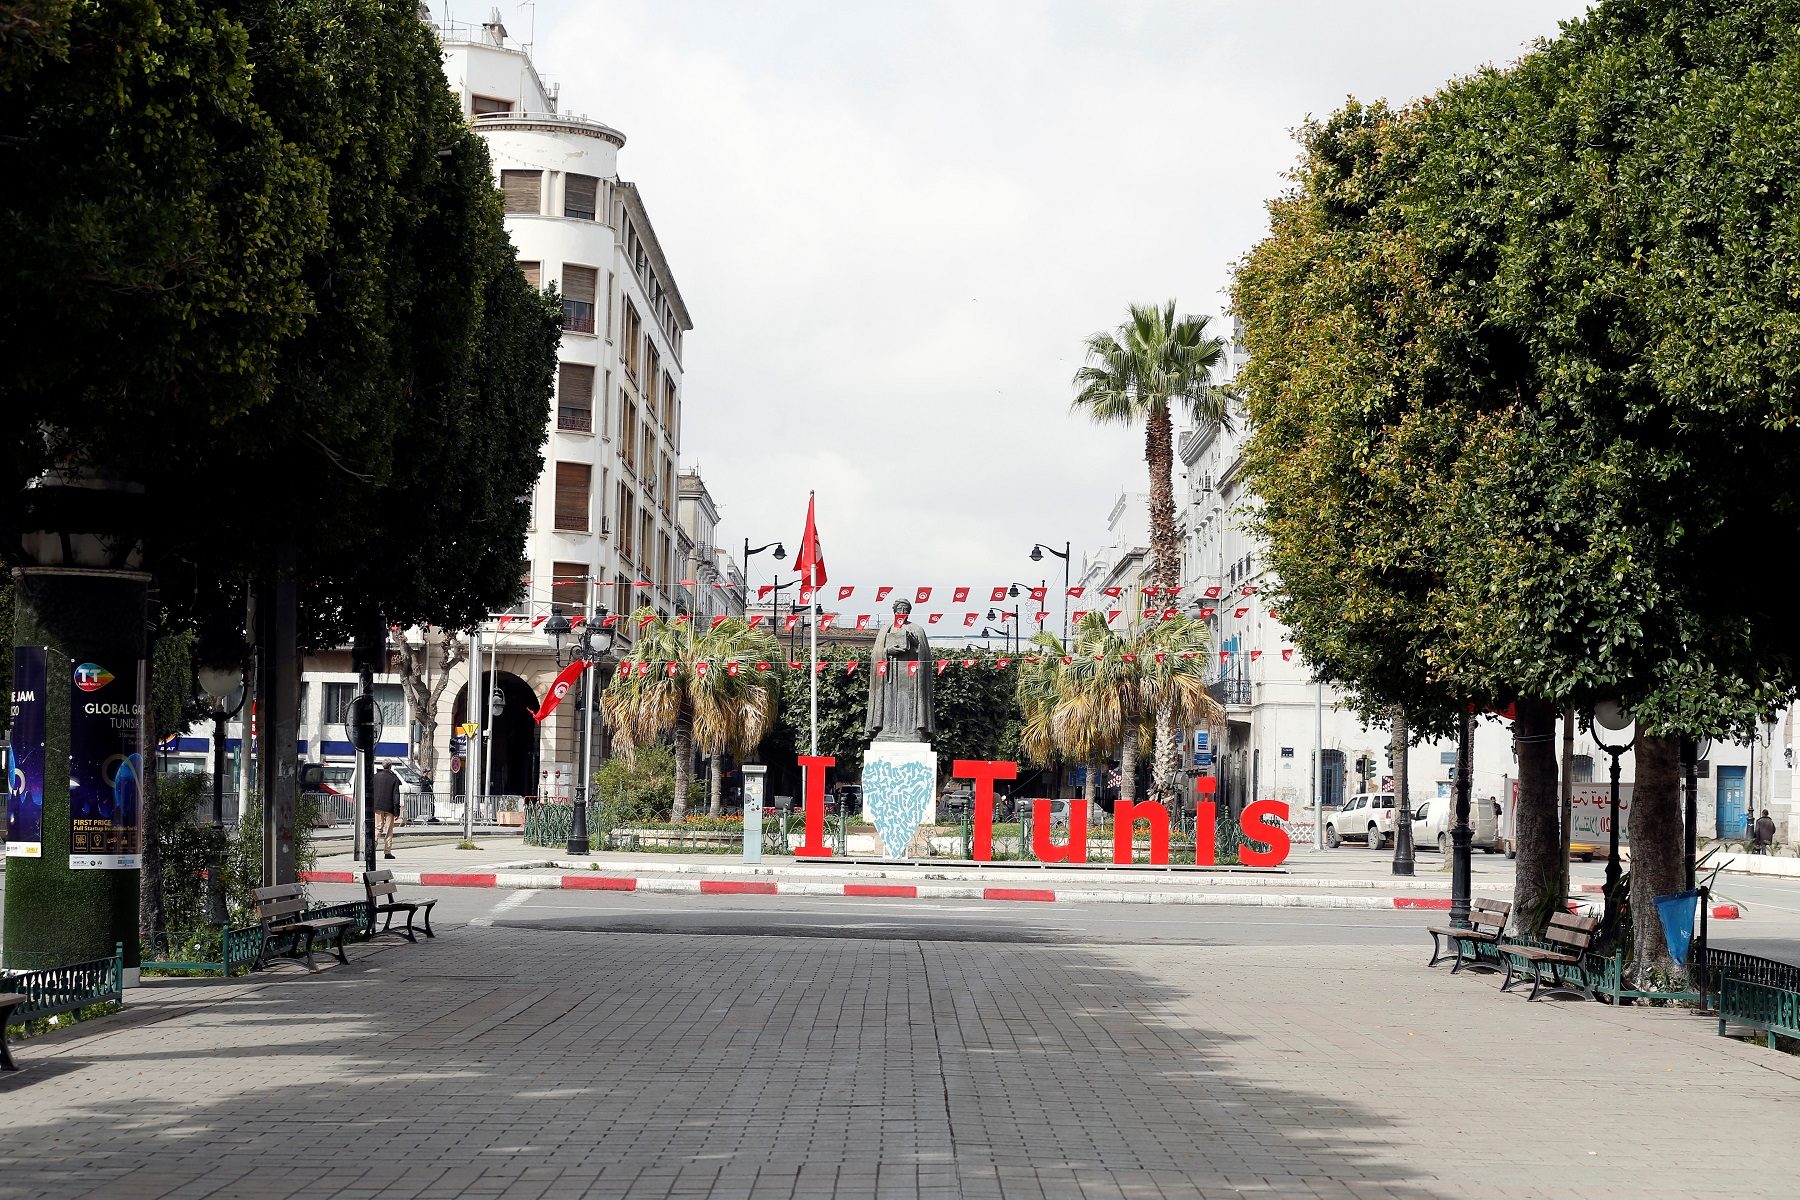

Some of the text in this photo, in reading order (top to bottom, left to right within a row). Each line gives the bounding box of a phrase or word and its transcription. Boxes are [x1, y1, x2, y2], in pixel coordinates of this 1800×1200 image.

[78, 669, 101, 682] TT
[15, 690, 34, 702] JAM
[85, 703, 130, 715] GLOBAL
[109, 717, 140, 729] TUNISIA
[795, 755, 836, 858] I
[952, 759, 1291, 867] Tunis
